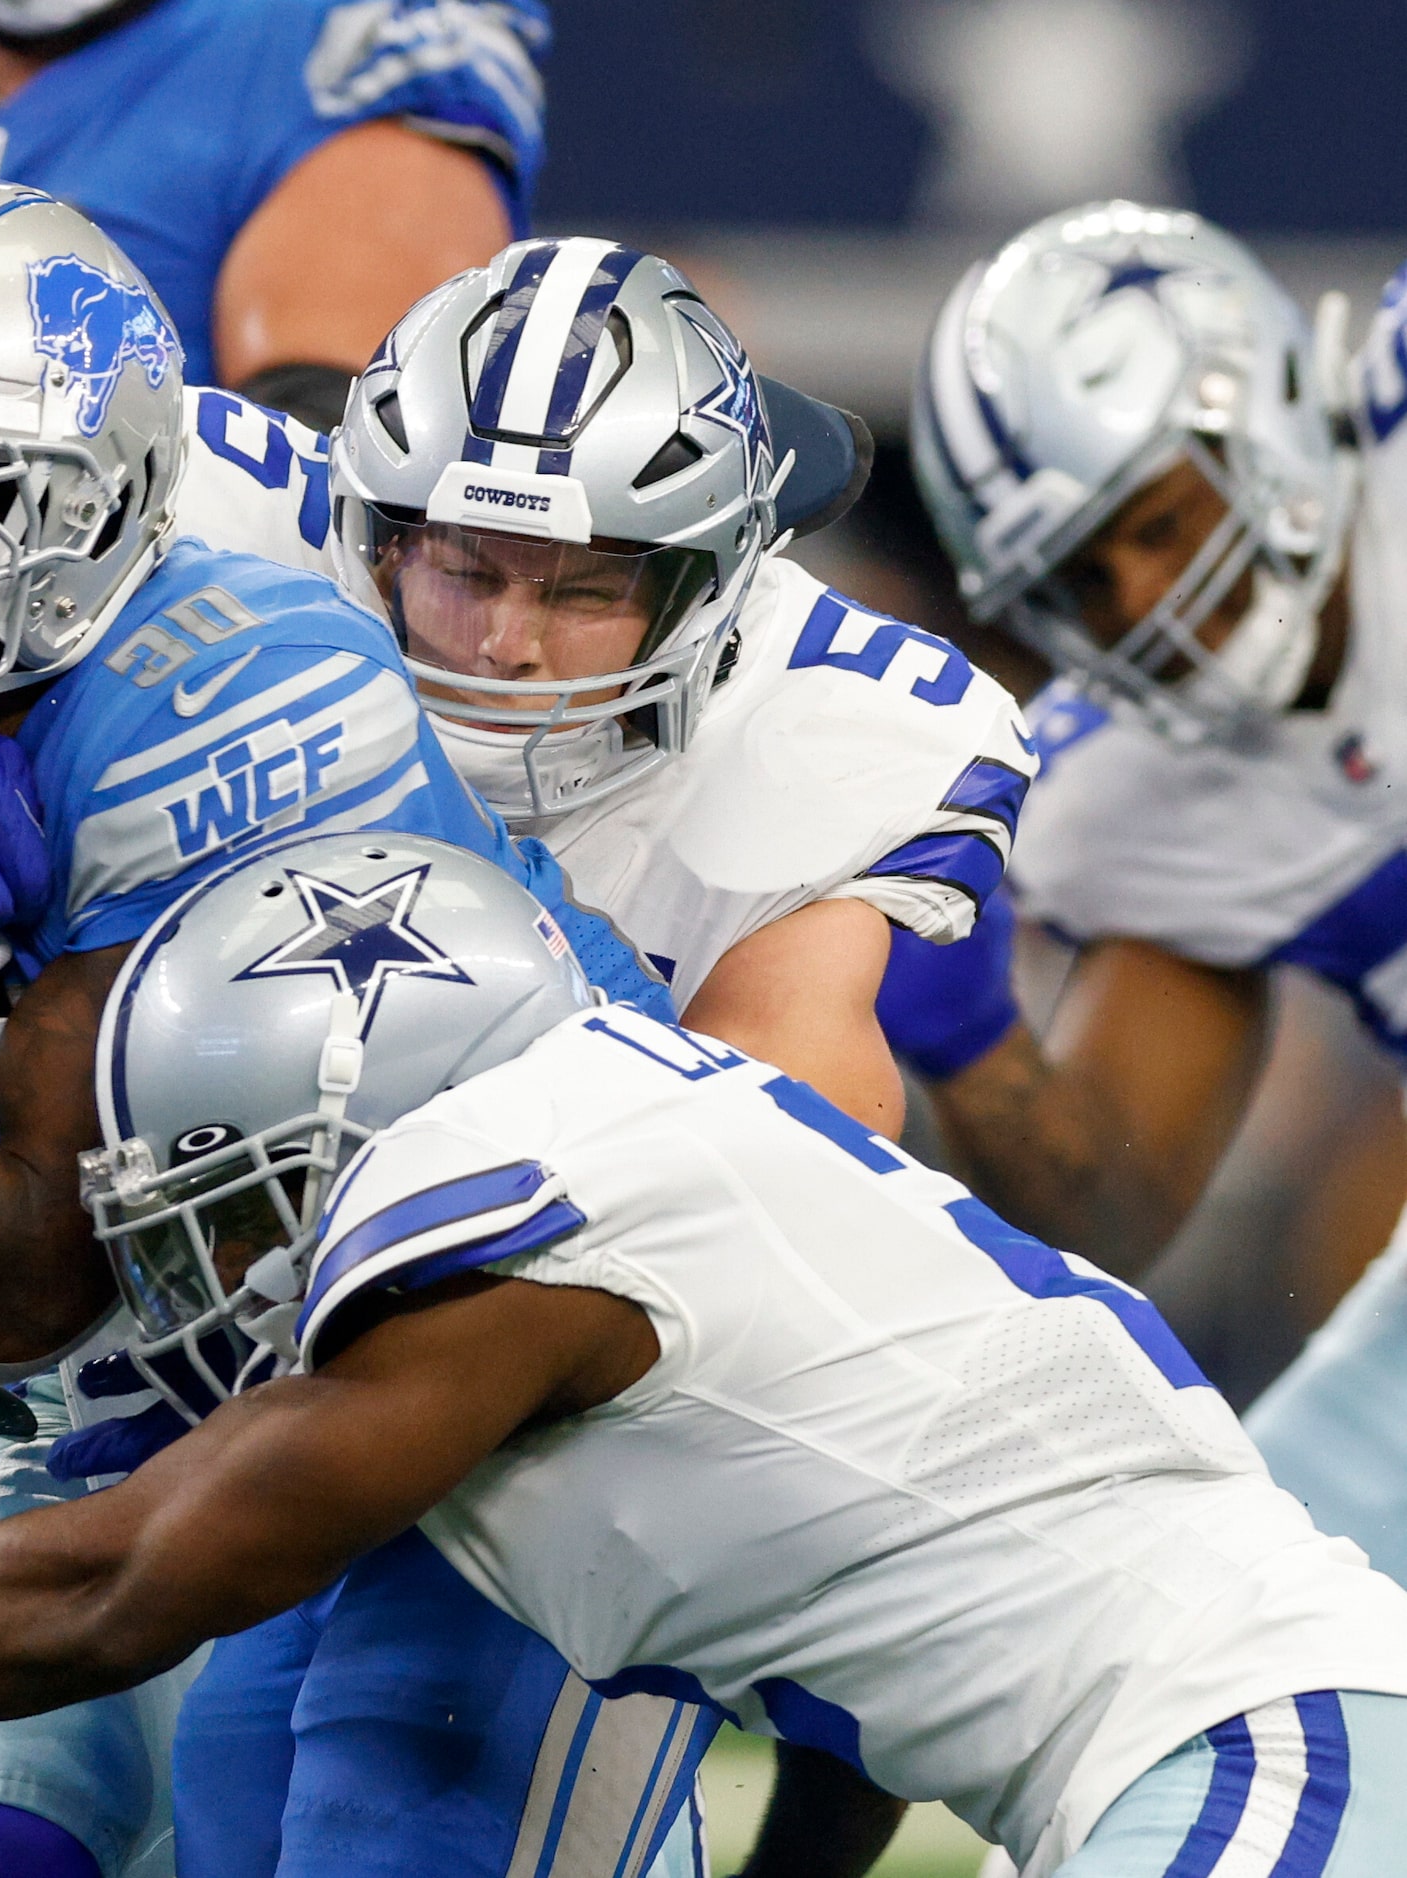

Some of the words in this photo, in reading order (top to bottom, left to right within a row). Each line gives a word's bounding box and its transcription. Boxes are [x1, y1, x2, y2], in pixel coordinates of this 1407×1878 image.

[464, 484, 551, 512] COWBOYS
[103, 585, 266, 688] 30
[786, 586, 975, 706] 5
[156, 720, 348, 862] WCF
